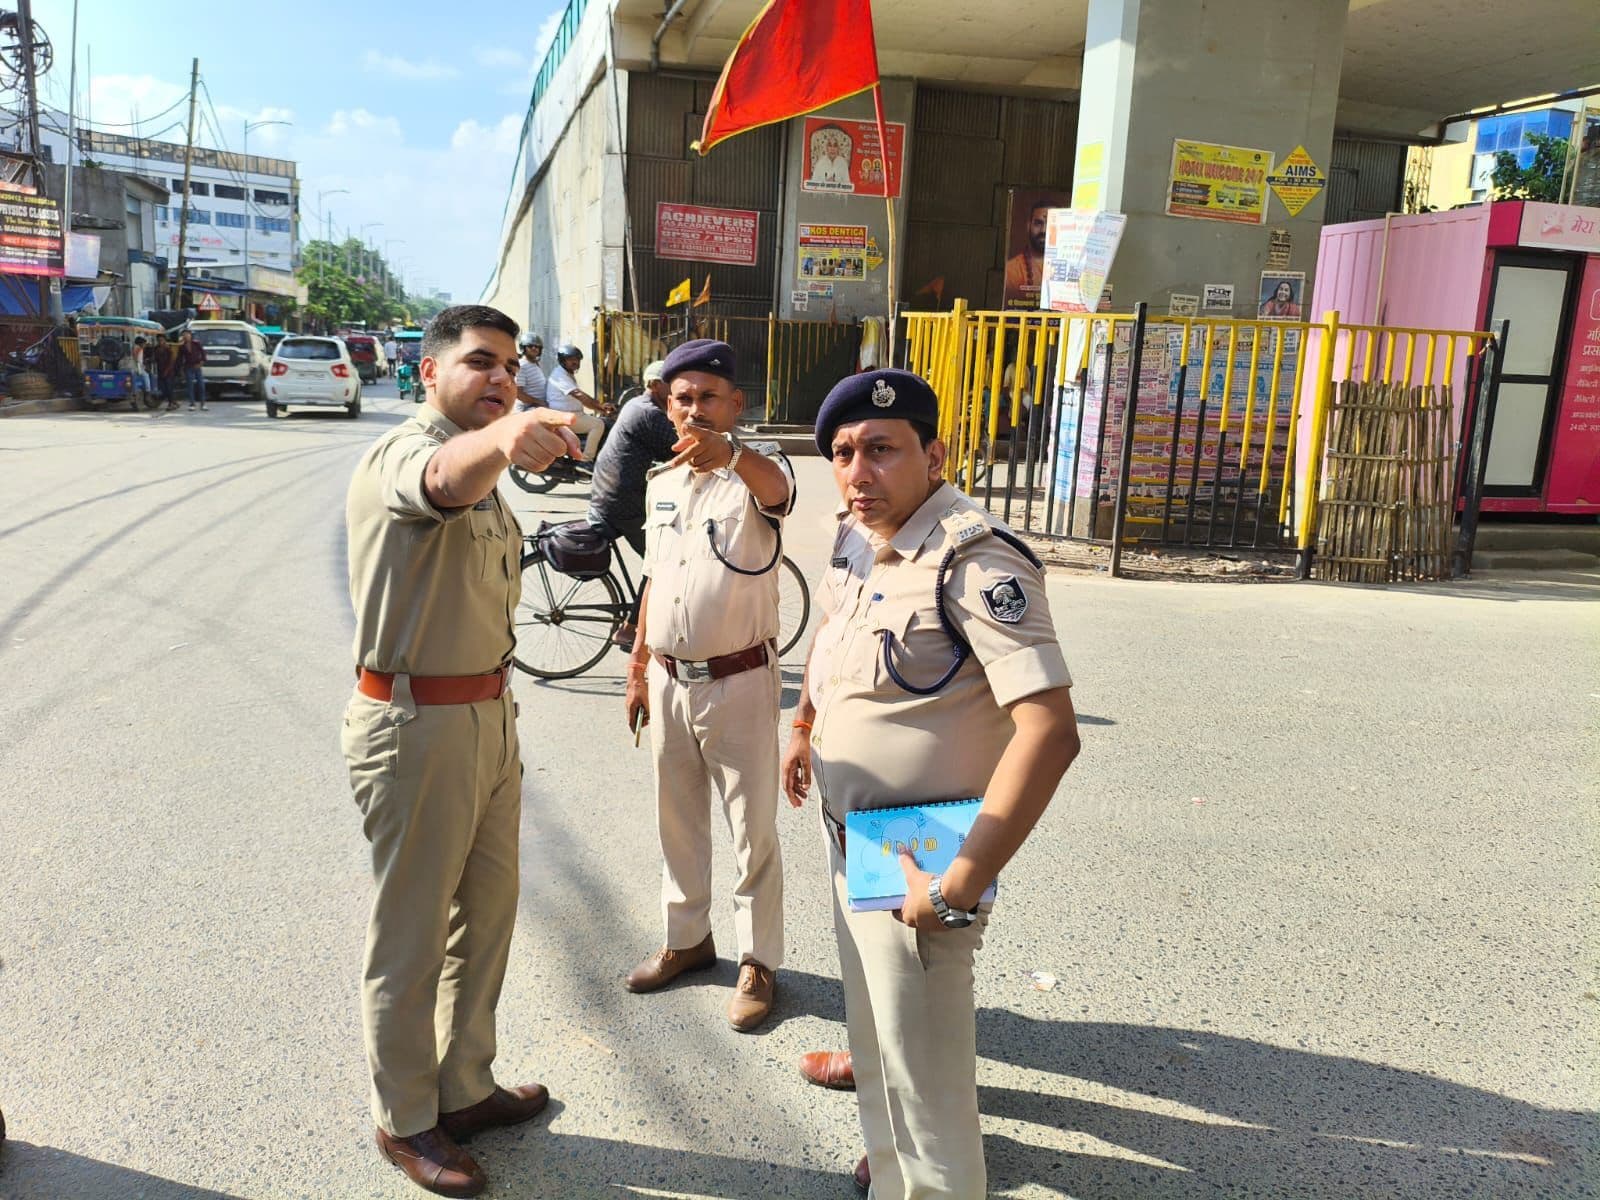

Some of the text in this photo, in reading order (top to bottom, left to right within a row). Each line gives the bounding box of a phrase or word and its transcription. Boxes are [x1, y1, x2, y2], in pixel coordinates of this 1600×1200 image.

[1285, 164, 1317, 177] AIMS
[29, 207, 60, 221] CLASSES
[662, 211, 755, 228] ACHIEVERS
[725, 225, 753, 233] PATNA
[1571, 214, 1594, 234] मेरा
[810, 226, 865, 237] KOS DENTICA
